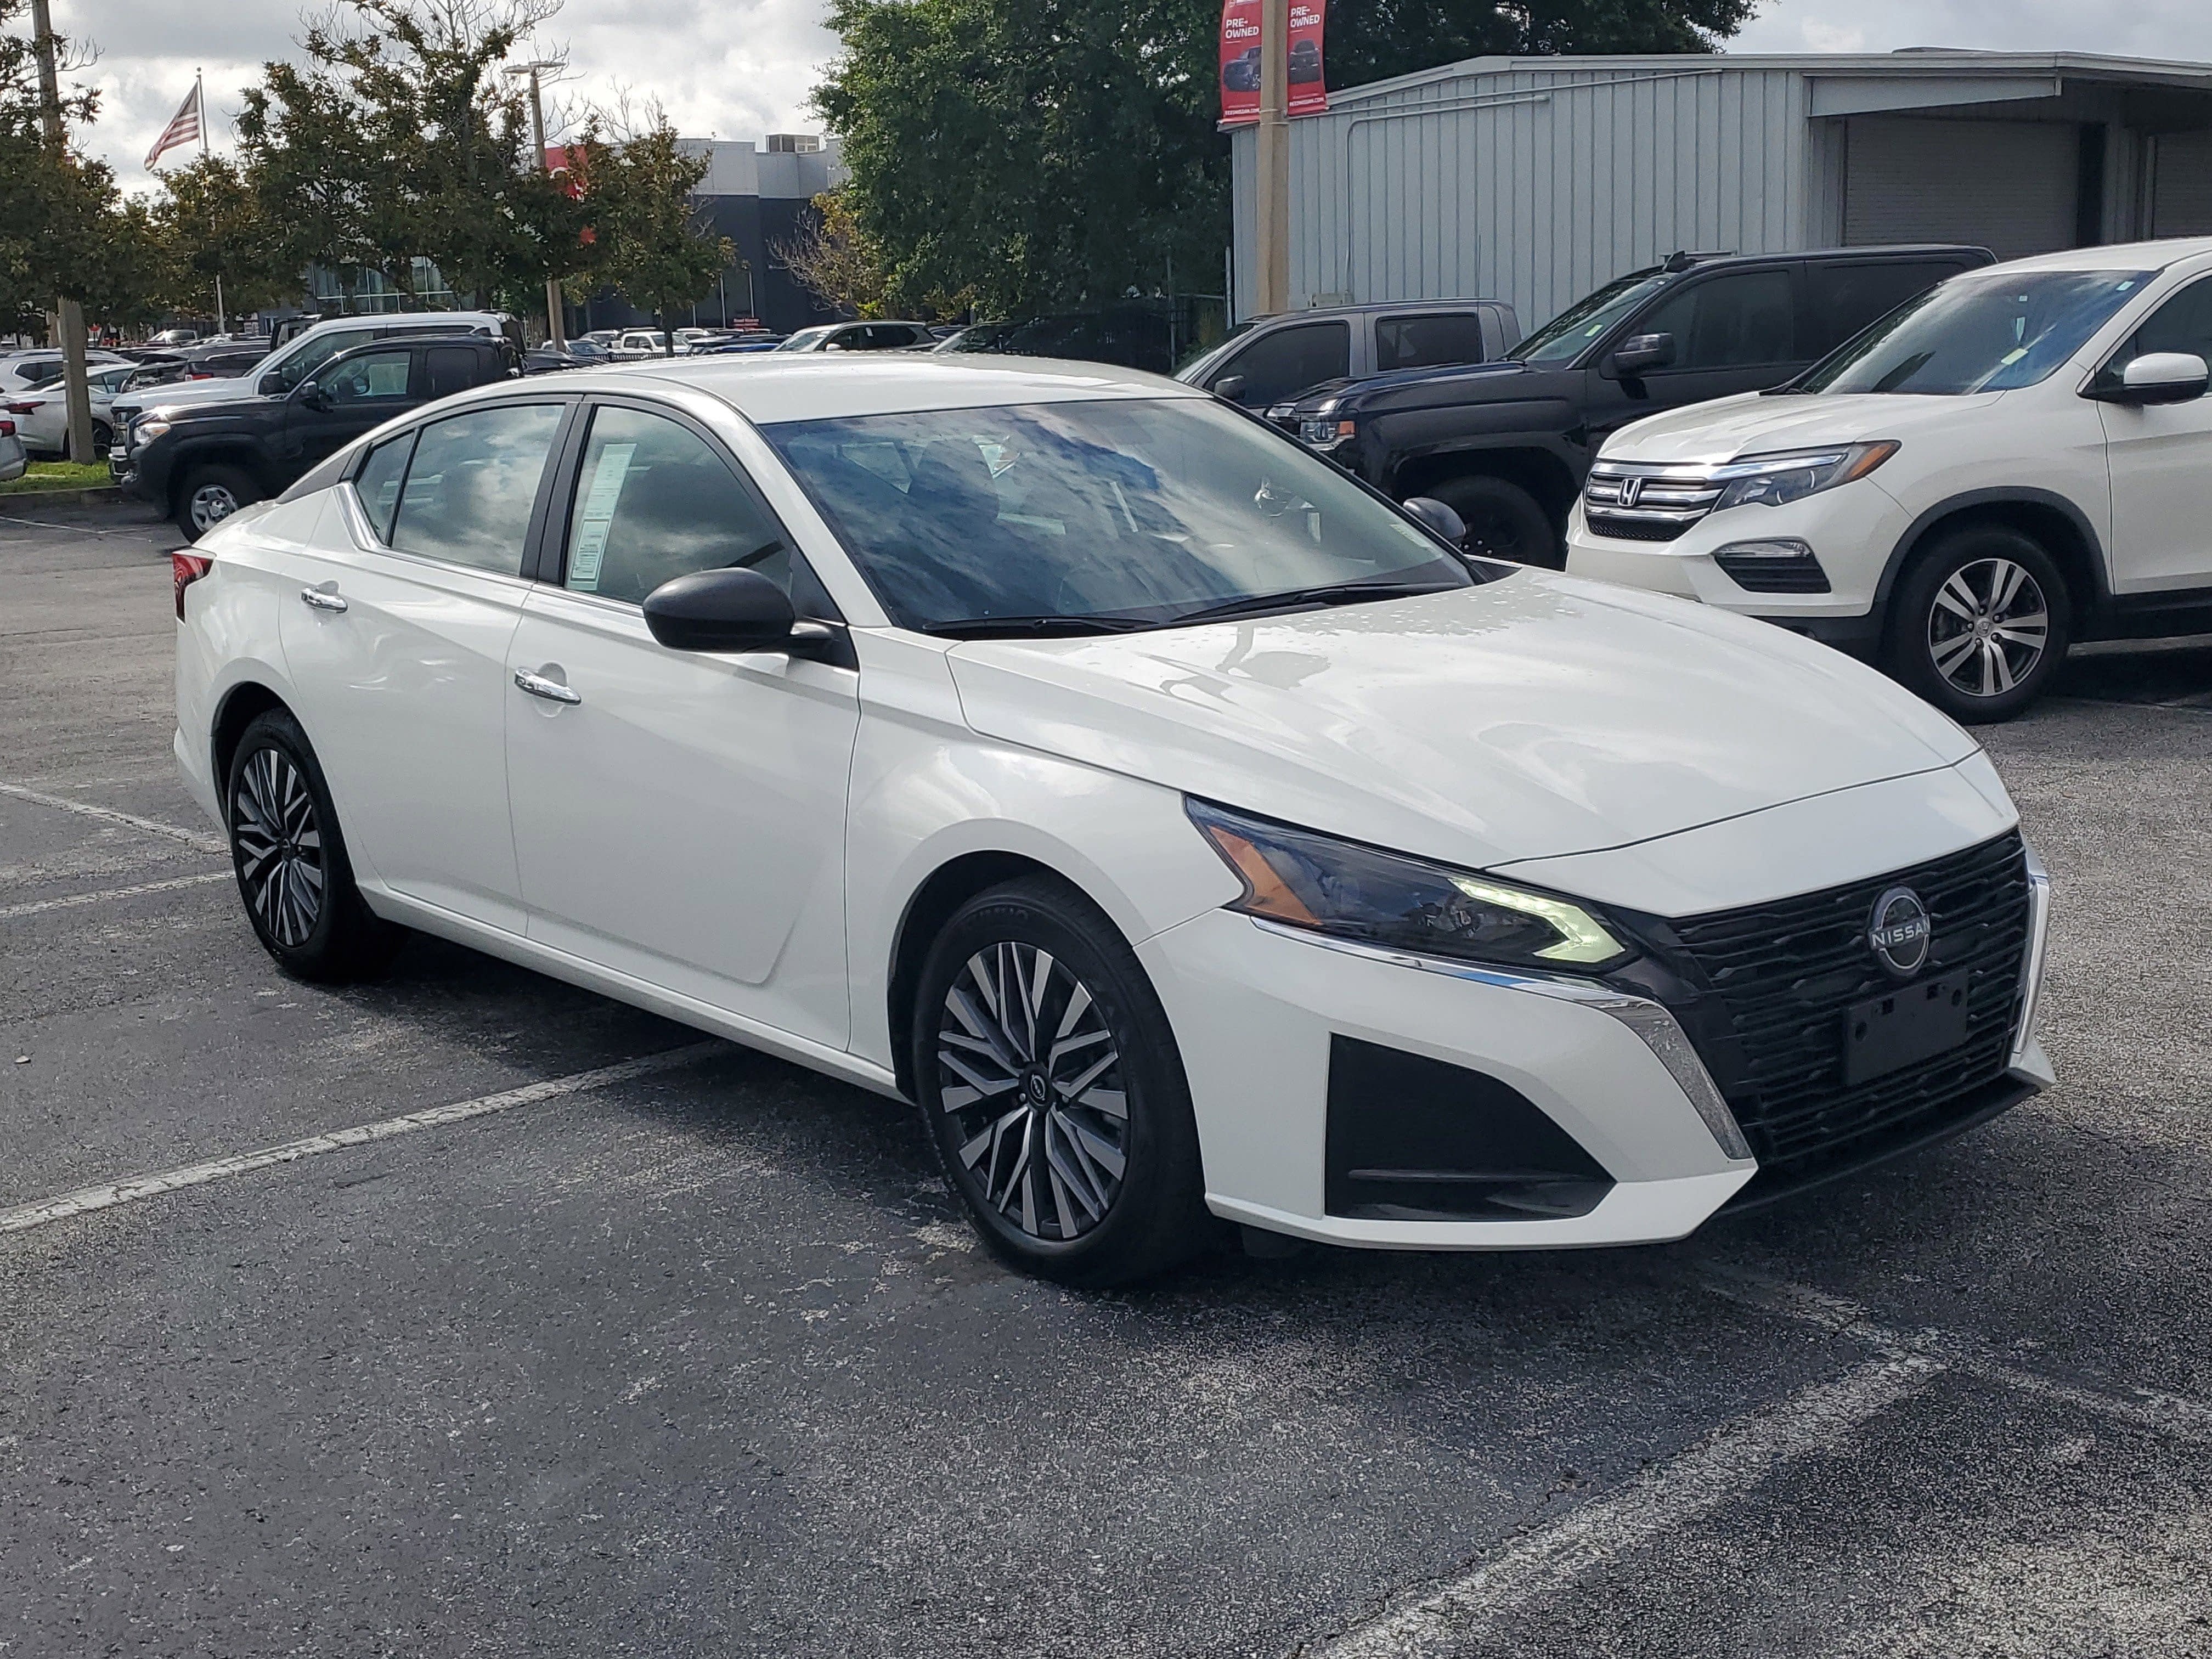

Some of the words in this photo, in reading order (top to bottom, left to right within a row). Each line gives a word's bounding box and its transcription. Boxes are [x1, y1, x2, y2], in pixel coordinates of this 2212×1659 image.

[1291, 6, 1310, 17] PRE-
[1226, 18, 1248, 29] PRE-
[1290, 14, 1320, 27] OWNED
[1226, 26, 1259, 38] OWNED
[1872, 919, 1929, 946] NISSAN
